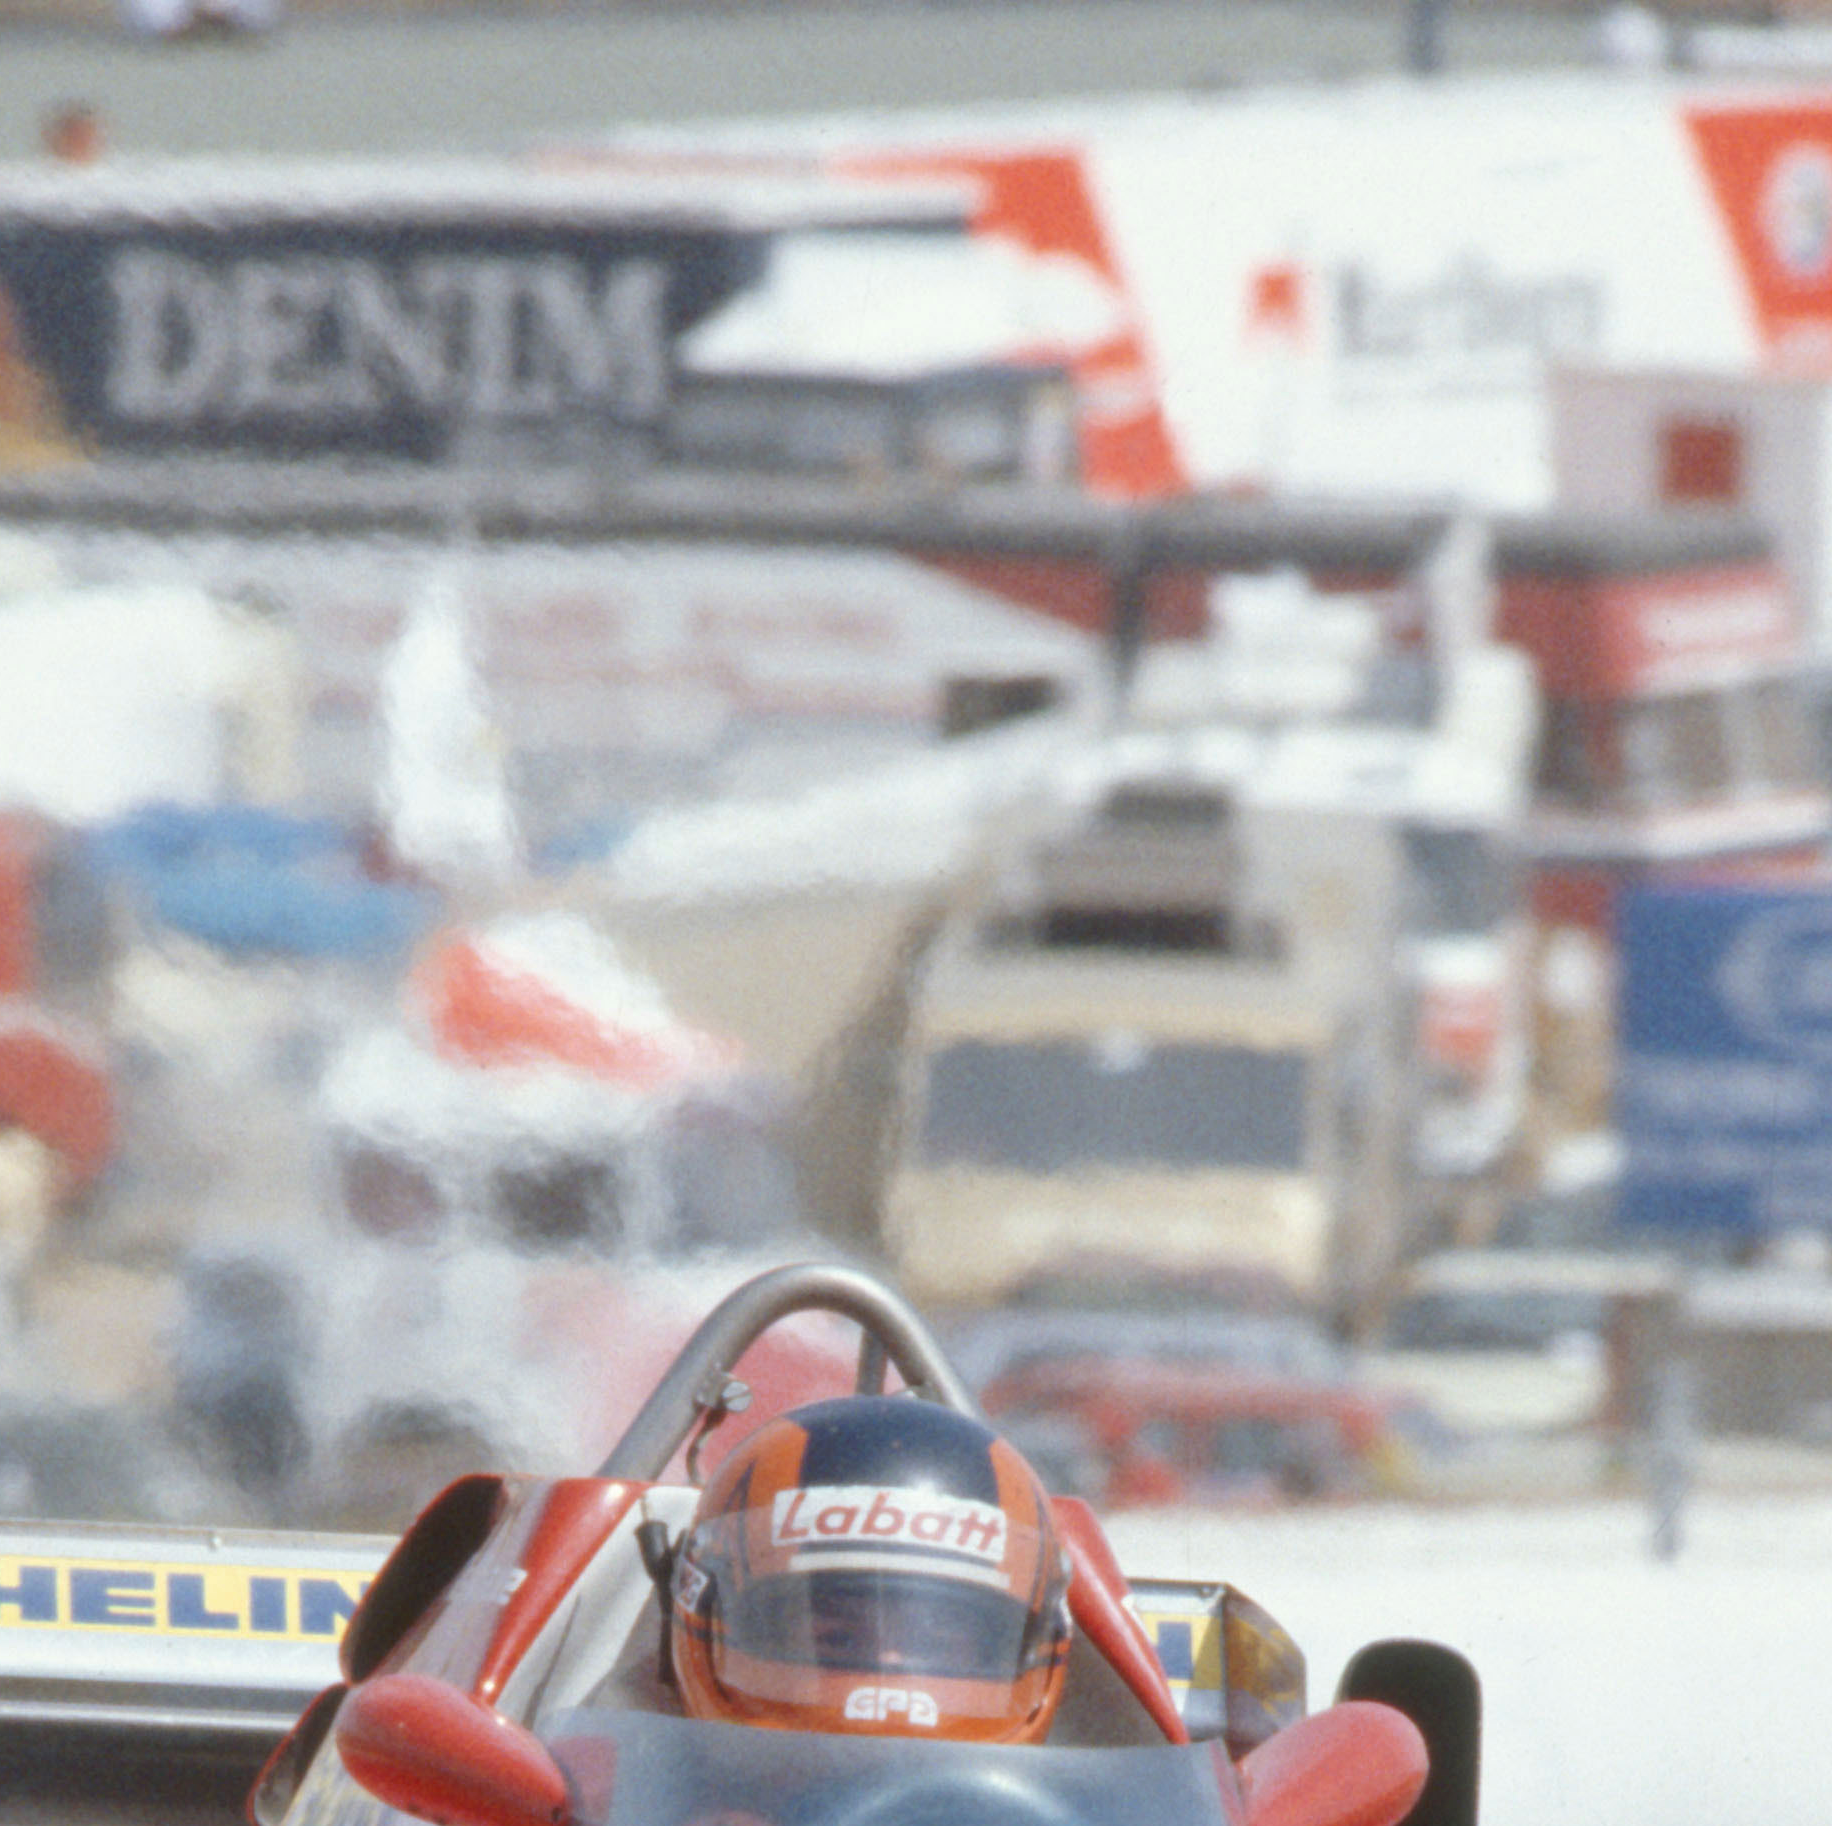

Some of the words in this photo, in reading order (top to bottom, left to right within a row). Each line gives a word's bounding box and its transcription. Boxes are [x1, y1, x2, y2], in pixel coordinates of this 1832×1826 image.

[107, 242, 667, 412] DENIM
[778, 1490, 1003, 1552] Labatt
[843, 1686, 939, 1729] GPA
